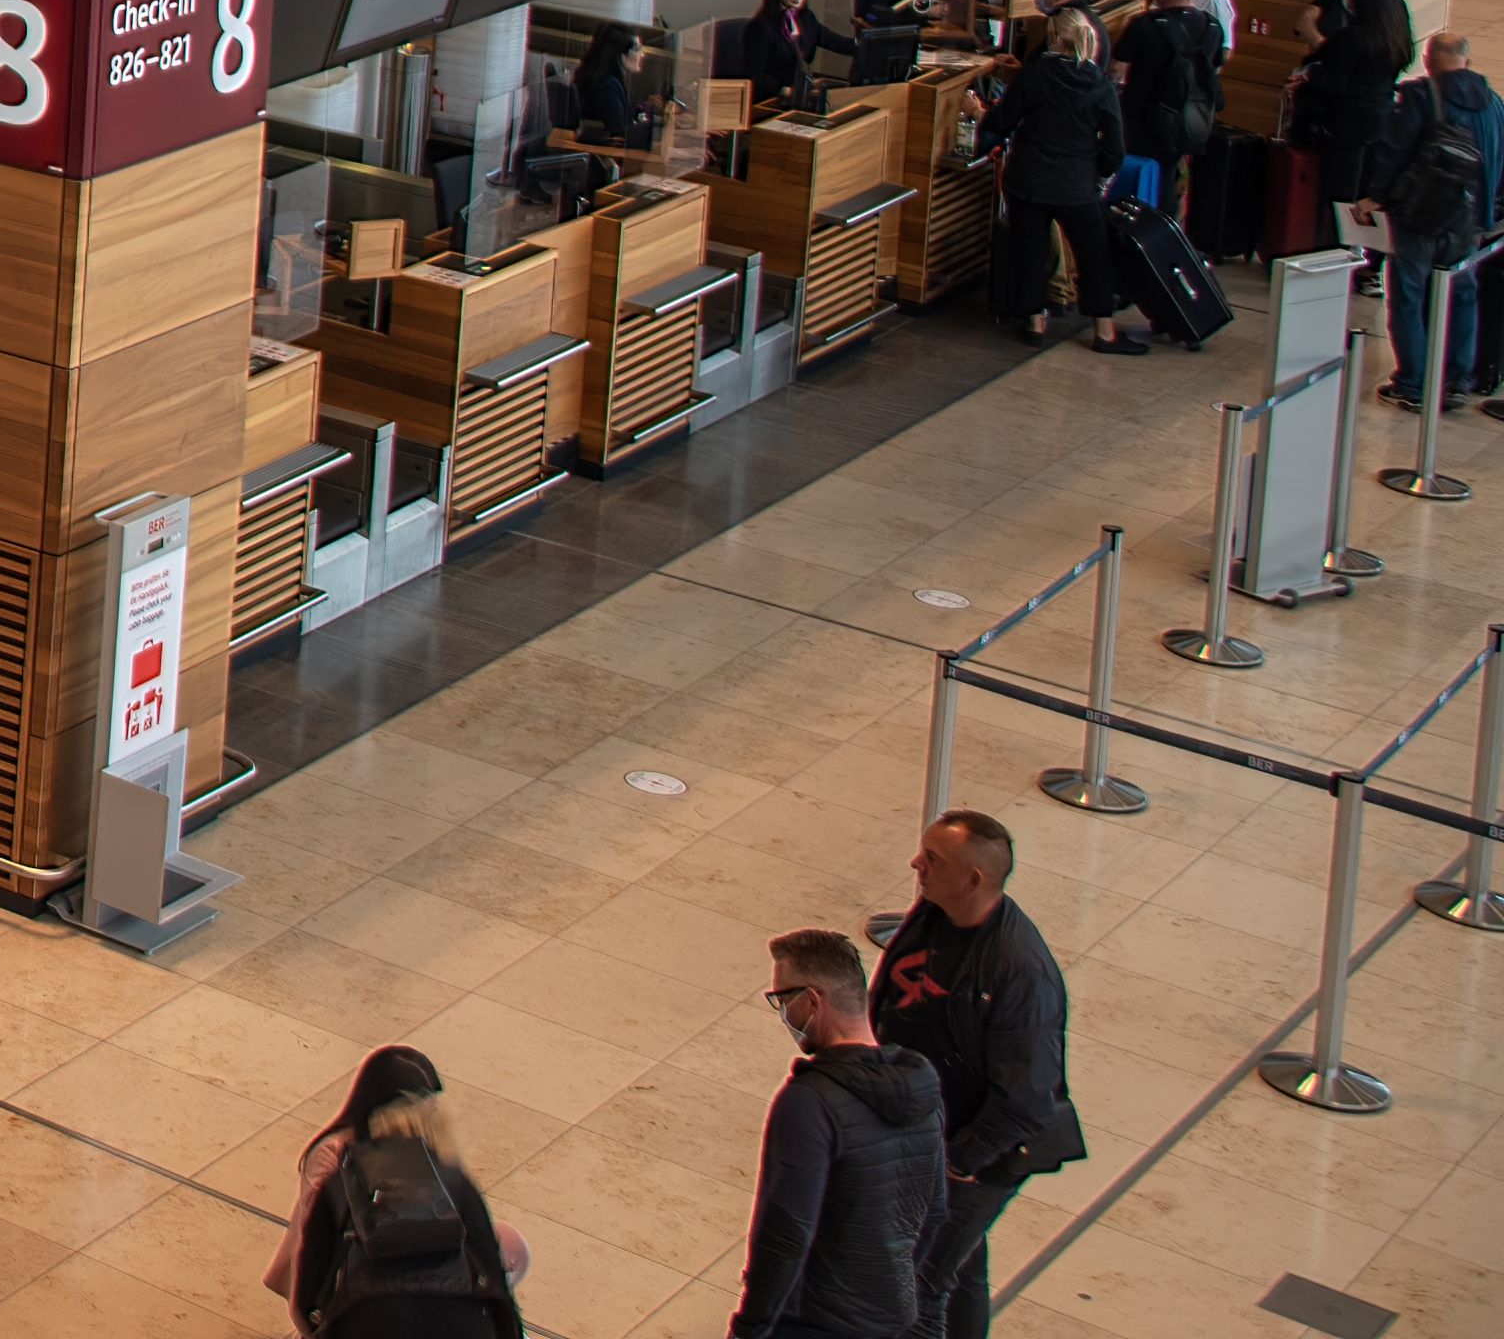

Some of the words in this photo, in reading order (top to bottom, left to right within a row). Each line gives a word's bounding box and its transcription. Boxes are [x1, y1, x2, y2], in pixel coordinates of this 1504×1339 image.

[109, 33, 192, 87] 826–821
[148, 515, 165, 535] BER
[1085, 709, 1110, 727] BER
[1247, 755, 1274, 772] BER
